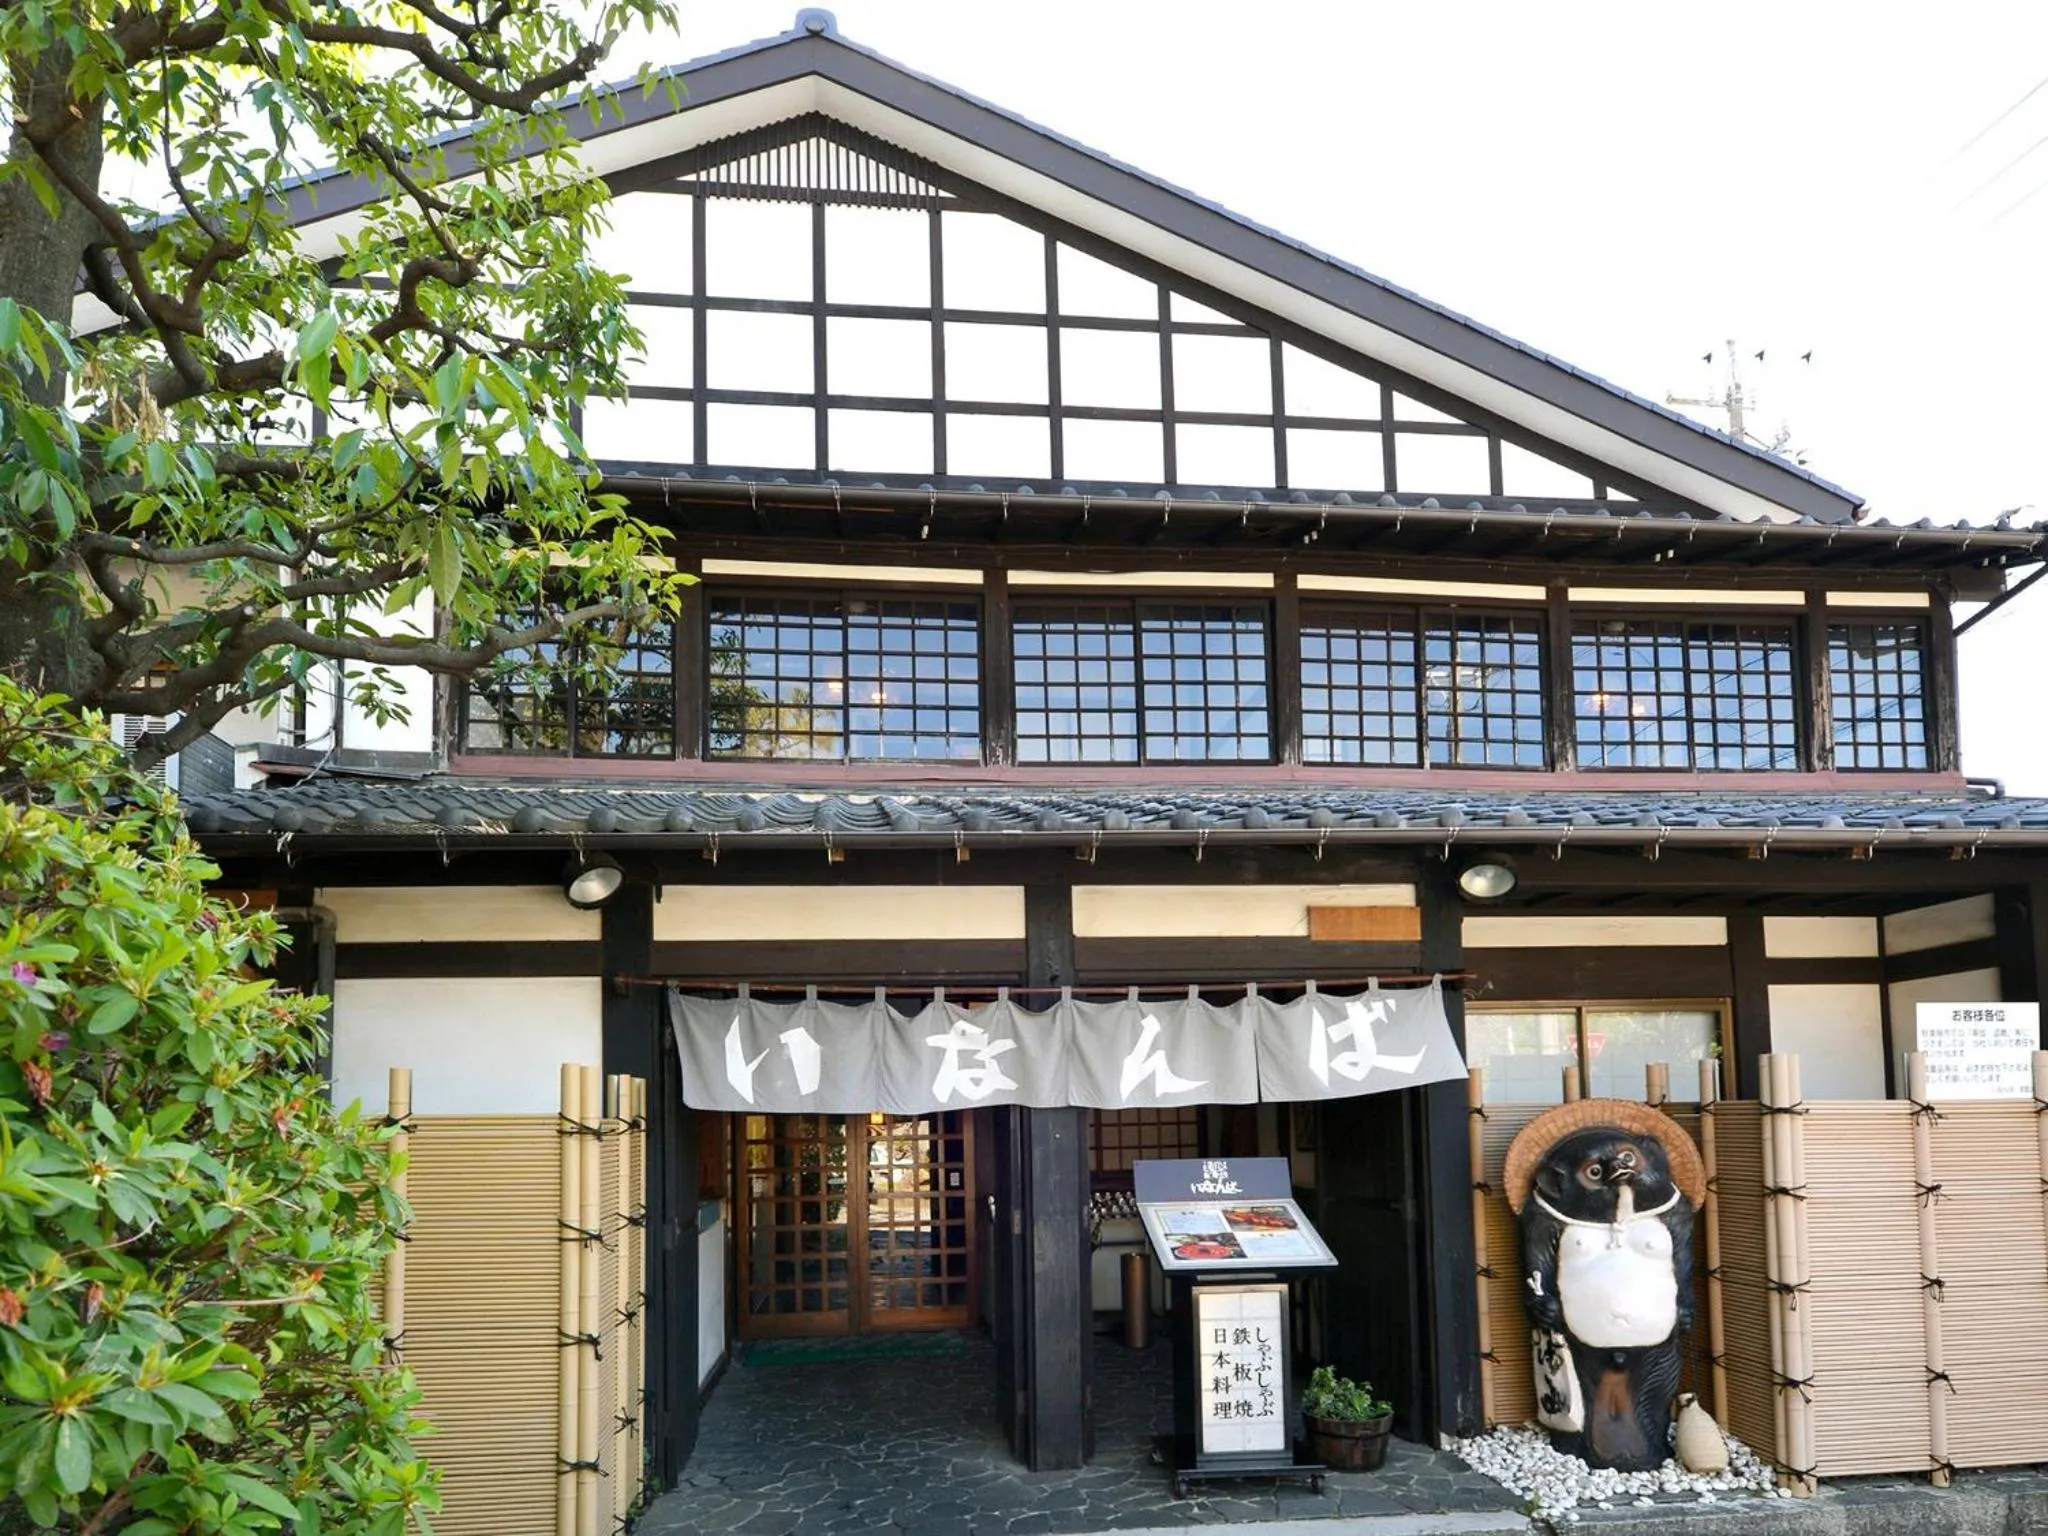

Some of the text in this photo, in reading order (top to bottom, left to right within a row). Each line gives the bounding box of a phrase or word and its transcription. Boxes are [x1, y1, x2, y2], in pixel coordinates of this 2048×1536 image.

[725, 999, 1427, 1104] いなんば
[1952, 1009, 2006, 1022] お客様各位
[1212, 1327, 1233, 1420] 日本料理
[1232, 1327, 1254, 1418] 鉄板焼
